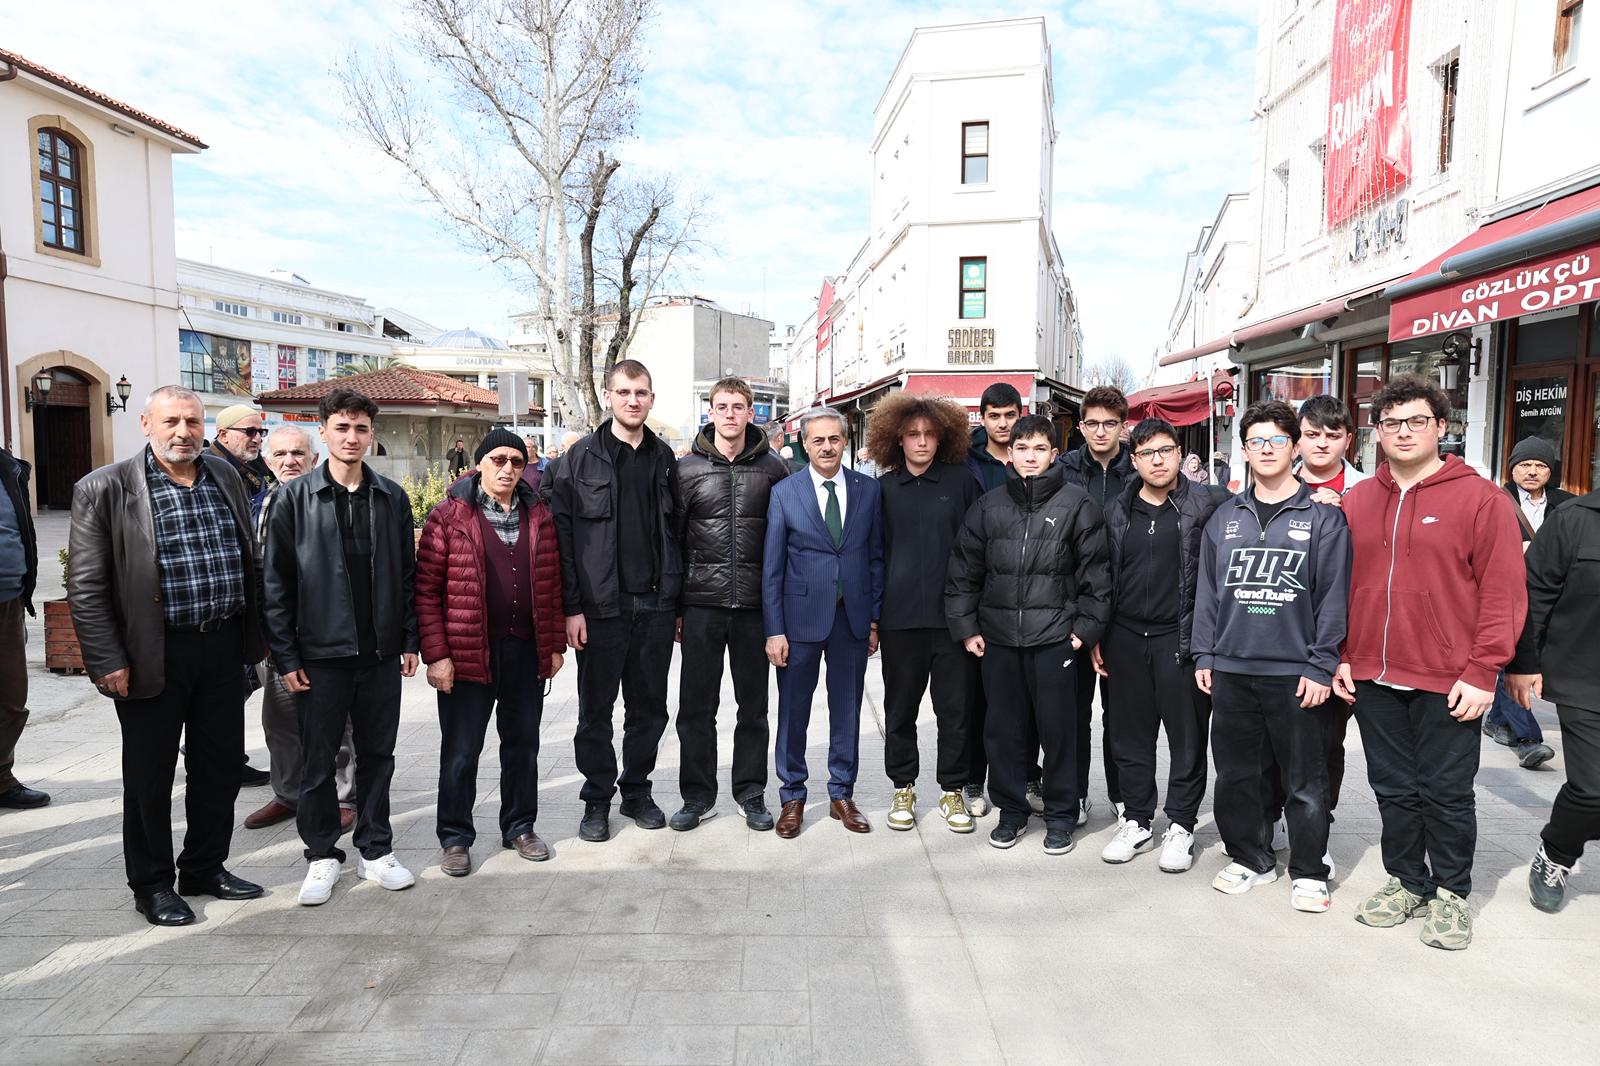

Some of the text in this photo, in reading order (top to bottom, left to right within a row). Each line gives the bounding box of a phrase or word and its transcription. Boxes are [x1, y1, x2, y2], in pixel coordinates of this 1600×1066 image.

[1411, 278, 1600, 336] DİVAN OPT
[947, 349, 994, 364] BAKLAVA
[1516, 387, 1532, 405] DİŞ
[1520, 406, 1562, 417] Semih AYGÜN
